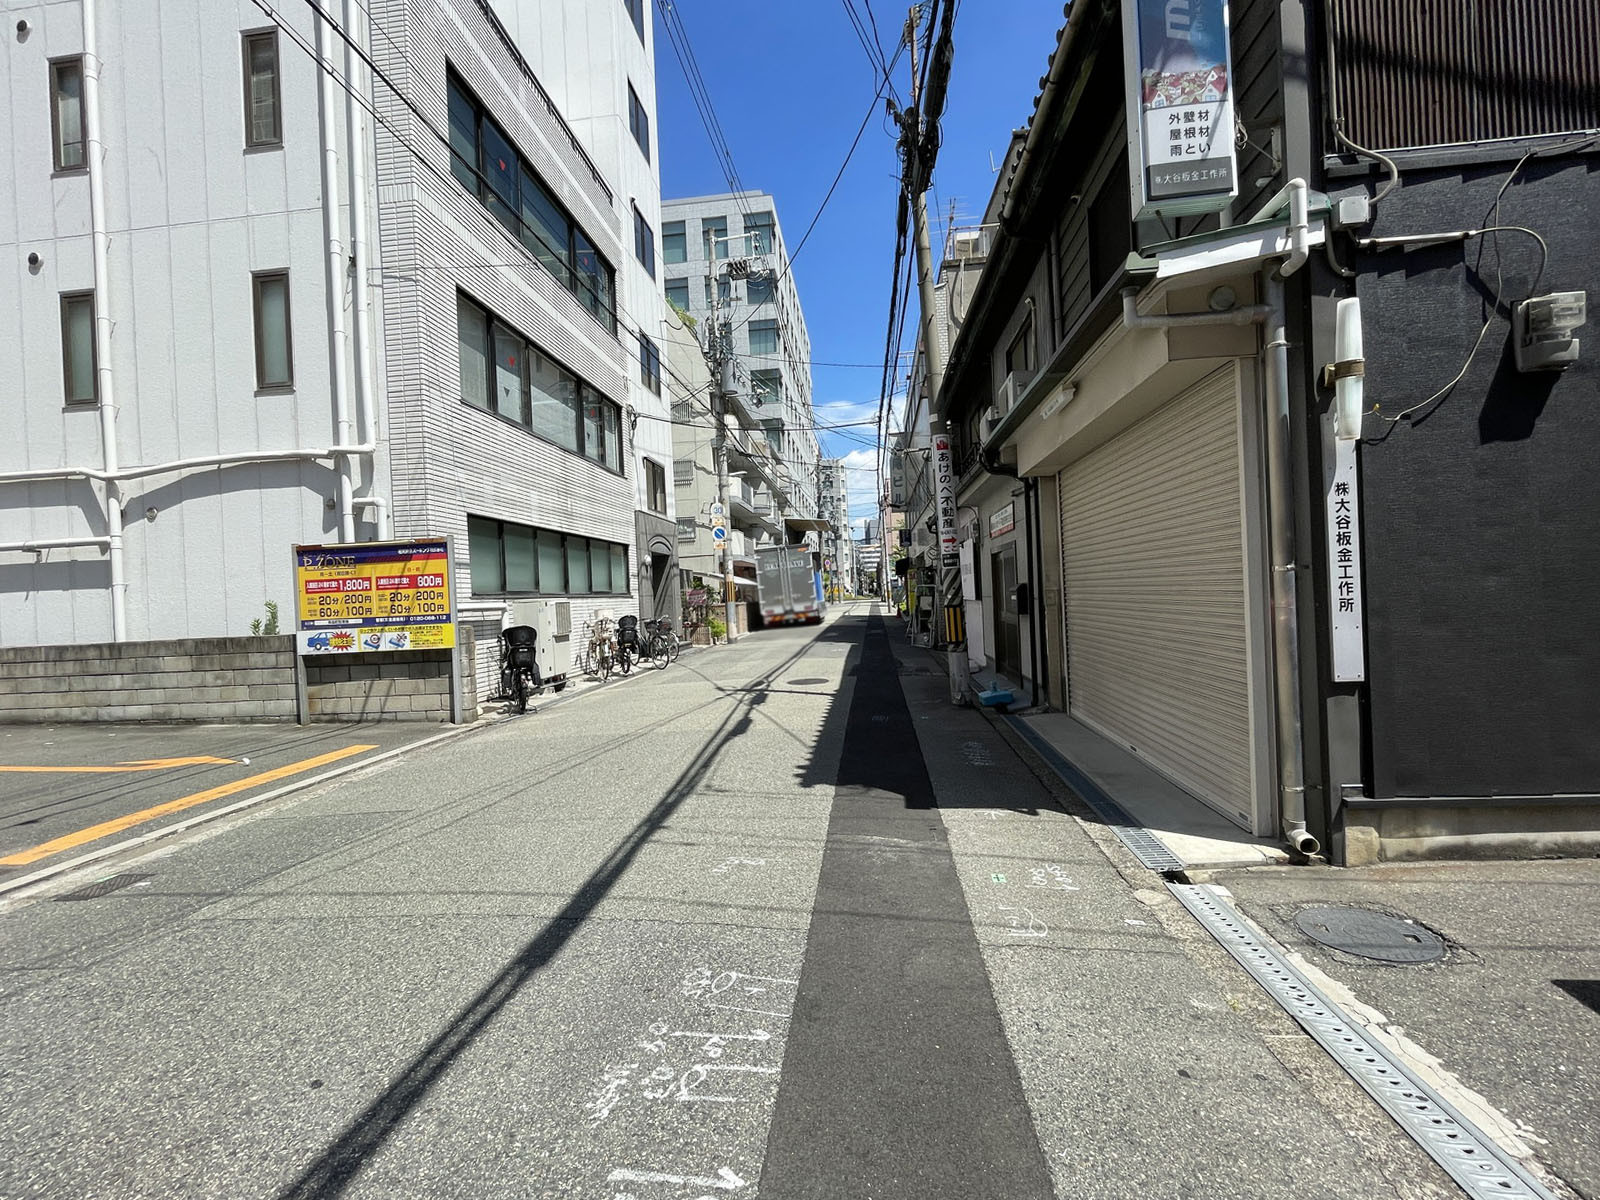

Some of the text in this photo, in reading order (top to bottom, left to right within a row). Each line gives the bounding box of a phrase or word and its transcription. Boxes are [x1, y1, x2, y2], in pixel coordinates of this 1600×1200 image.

[1169, 109, 1209, 125] 外壁材
[1170, 125, 1210, 141] 屋根材
[1170, 143, 1211, 157] 雨とい
[938, 452, 954, 528] あけのべ不動産
[339, 579, 370, 592] 1,800円
